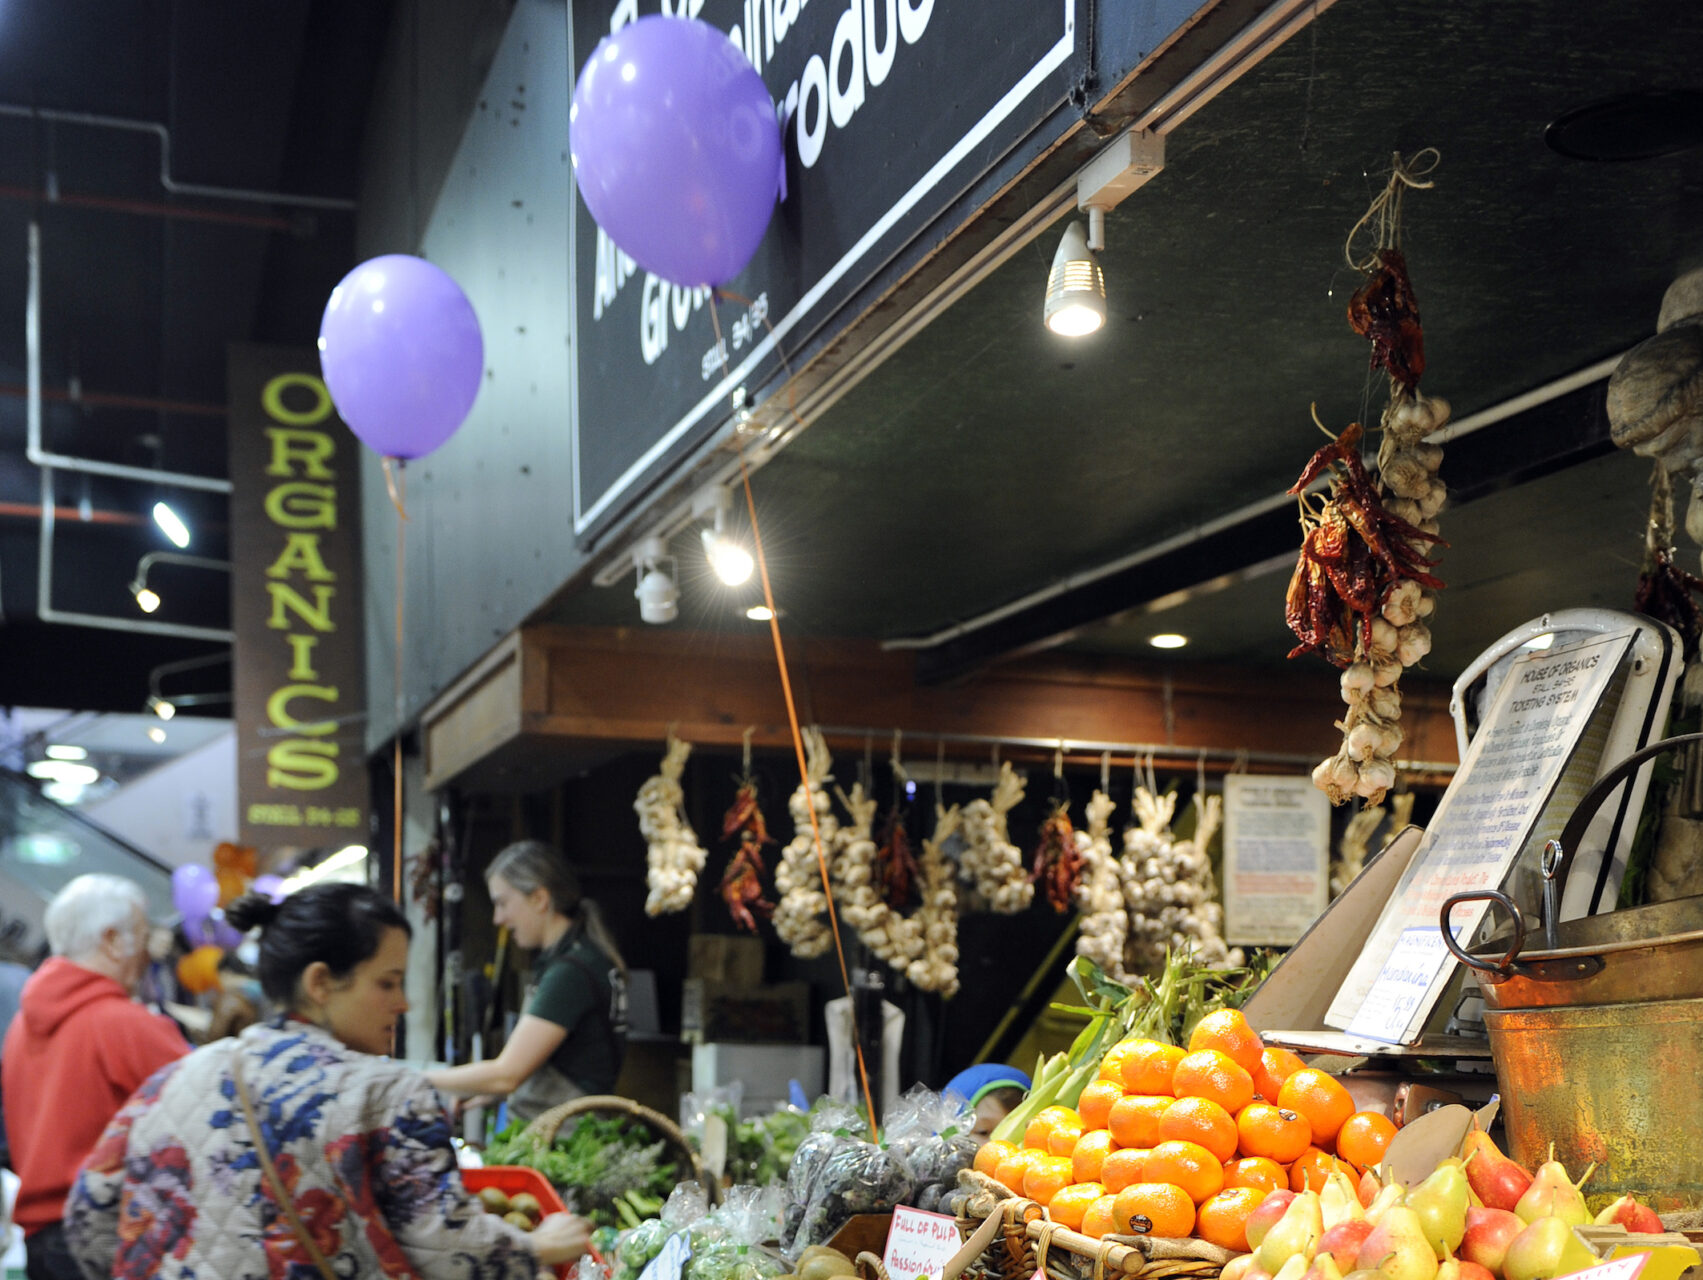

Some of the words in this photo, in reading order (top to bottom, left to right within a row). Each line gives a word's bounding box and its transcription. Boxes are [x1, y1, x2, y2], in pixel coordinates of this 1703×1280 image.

[261, 372, 340, 790] ORGANICS
[1520, 671, 1547, 684] HOUSE
[1547, 665, 1558, 679] OF
[1556, 655, 1600, 677] ORGANICS
[1546, 689, 1580, 708] SYSTEM
[895, 1214, 915, 1234] FULL
[917, 1221, 929, 1236] OF
[932, 1221, 957, 1242] PULP
